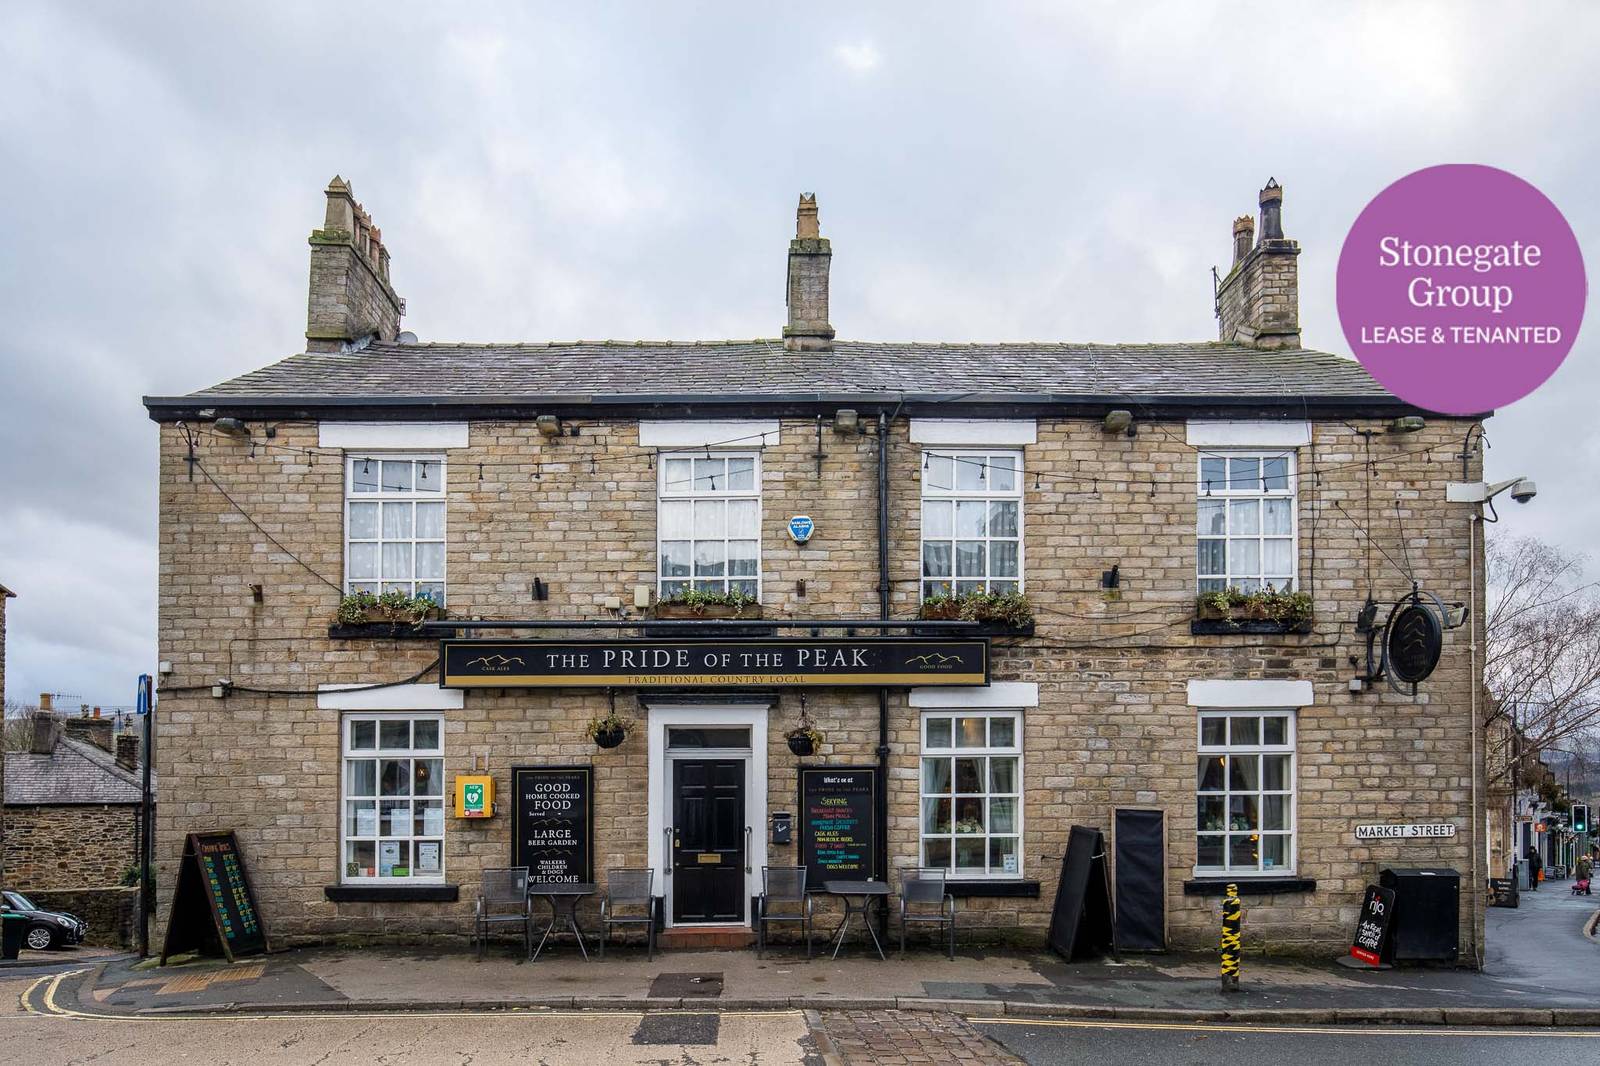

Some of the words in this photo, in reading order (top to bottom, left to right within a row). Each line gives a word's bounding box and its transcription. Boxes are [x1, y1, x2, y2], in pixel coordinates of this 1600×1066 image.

[546, 654, 590, 668] THE
[602, 649, 690, 668] PRIDE
[704, 653, 731, 667] OF
[740, 653, 783, 667] THE
[797, 648, 868, 667] PEAK
[627, 676, 704, 684] TRADITIONAL
[710, 675, 764, 684] COUNTRY
[769, 675, 807, 683] LOCAL
[535, 783, 571, 792] GOOD
[534, 800, 572, 810] FOOD
[534, 829, 572, 839] LARGE
[1358, 825, 1406, 837] MARKET
[1411, 824, 1453, 836] STREET
[528, 875, 580, 883] WELCOME
